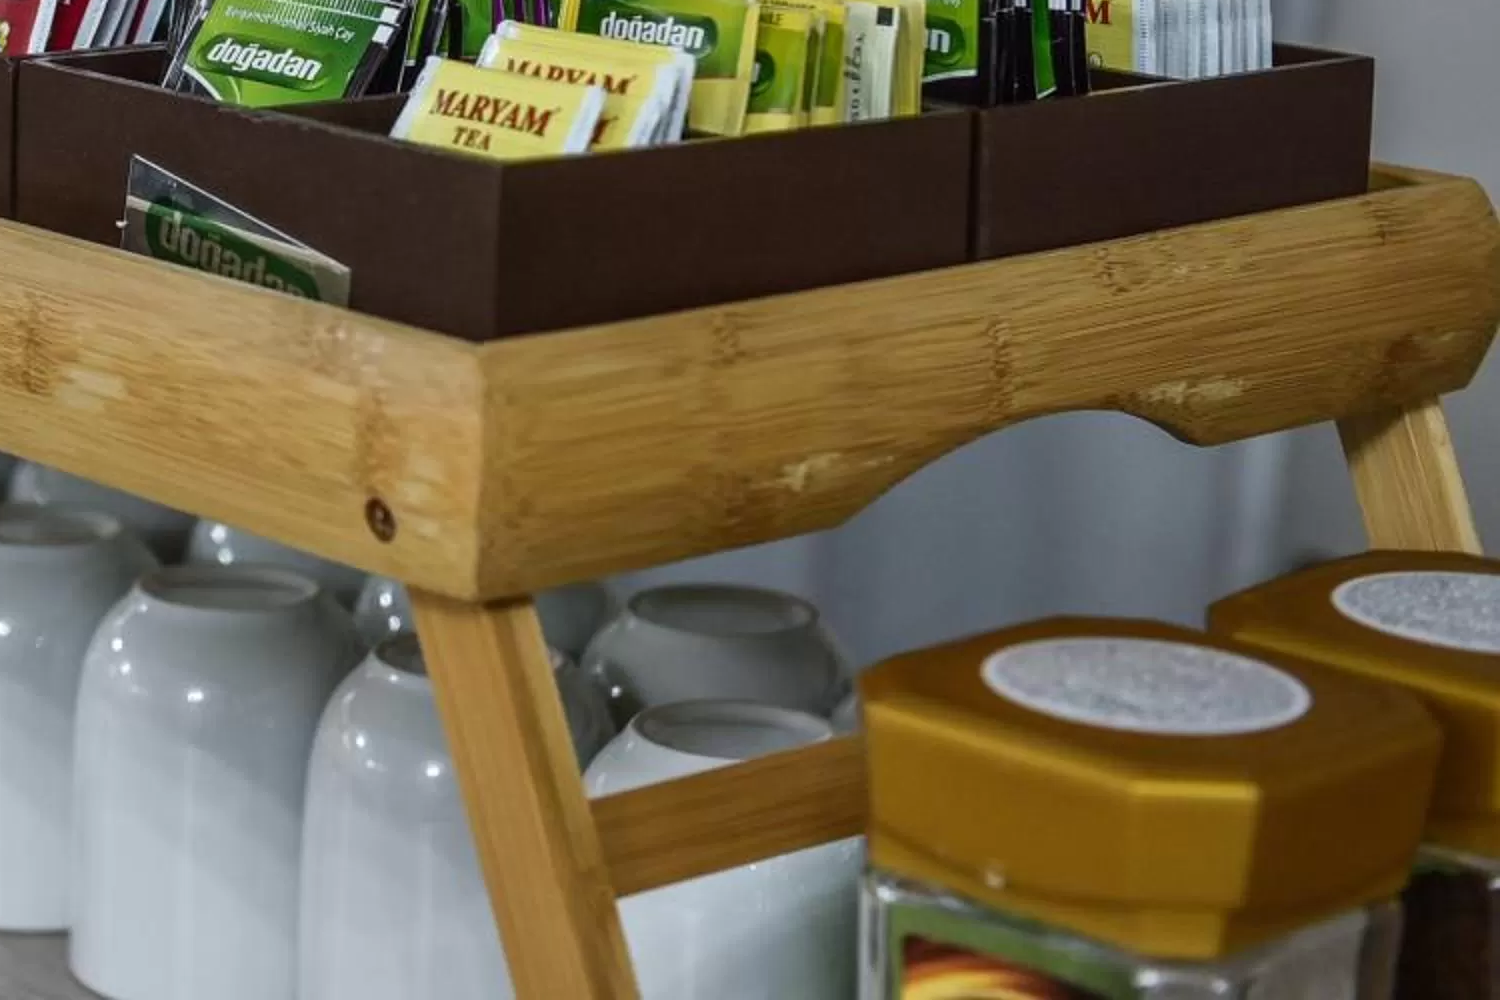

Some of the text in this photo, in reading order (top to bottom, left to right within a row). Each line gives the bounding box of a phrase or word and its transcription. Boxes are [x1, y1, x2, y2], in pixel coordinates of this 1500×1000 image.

[207, 37, 323, 81] doğadan
[429, 89, 552, 137] MARYAM
[452, 126, 493, 151] TEA
[159, 208, 306, 297] doğad
